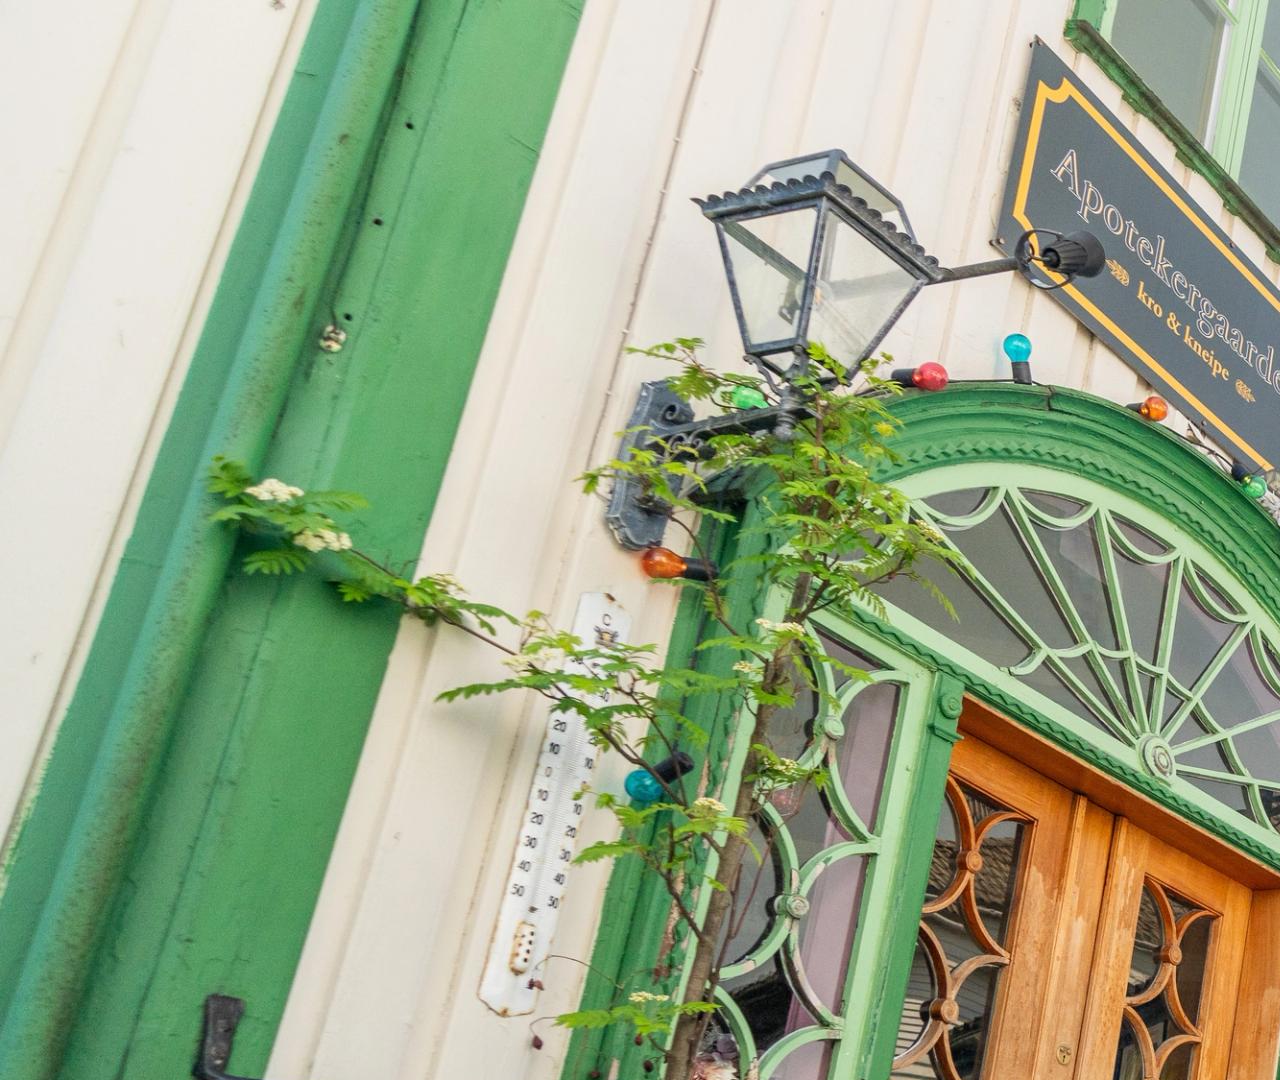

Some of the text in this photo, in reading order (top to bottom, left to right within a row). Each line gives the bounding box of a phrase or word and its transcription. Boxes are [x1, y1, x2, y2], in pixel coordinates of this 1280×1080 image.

[1137, 280, 1230, 381] kro & kneipe
[553, 719, 567, 733] 20
[549, 742, 560, 755] 10
[545, 766, 553, 778] 0
[538, 788, 549, 802] 10
[574, 803, 583, 816] 10
[531, 812, 544, 825] 20
[566, 825, 577, 839] 20
[524, 835, 538, 849] 30
[560, 848, 571, 862] 30
[518, 859, 531, 873] 40
[553, 872, 566, 885] 40
[511, 883, 525, 897] 50
